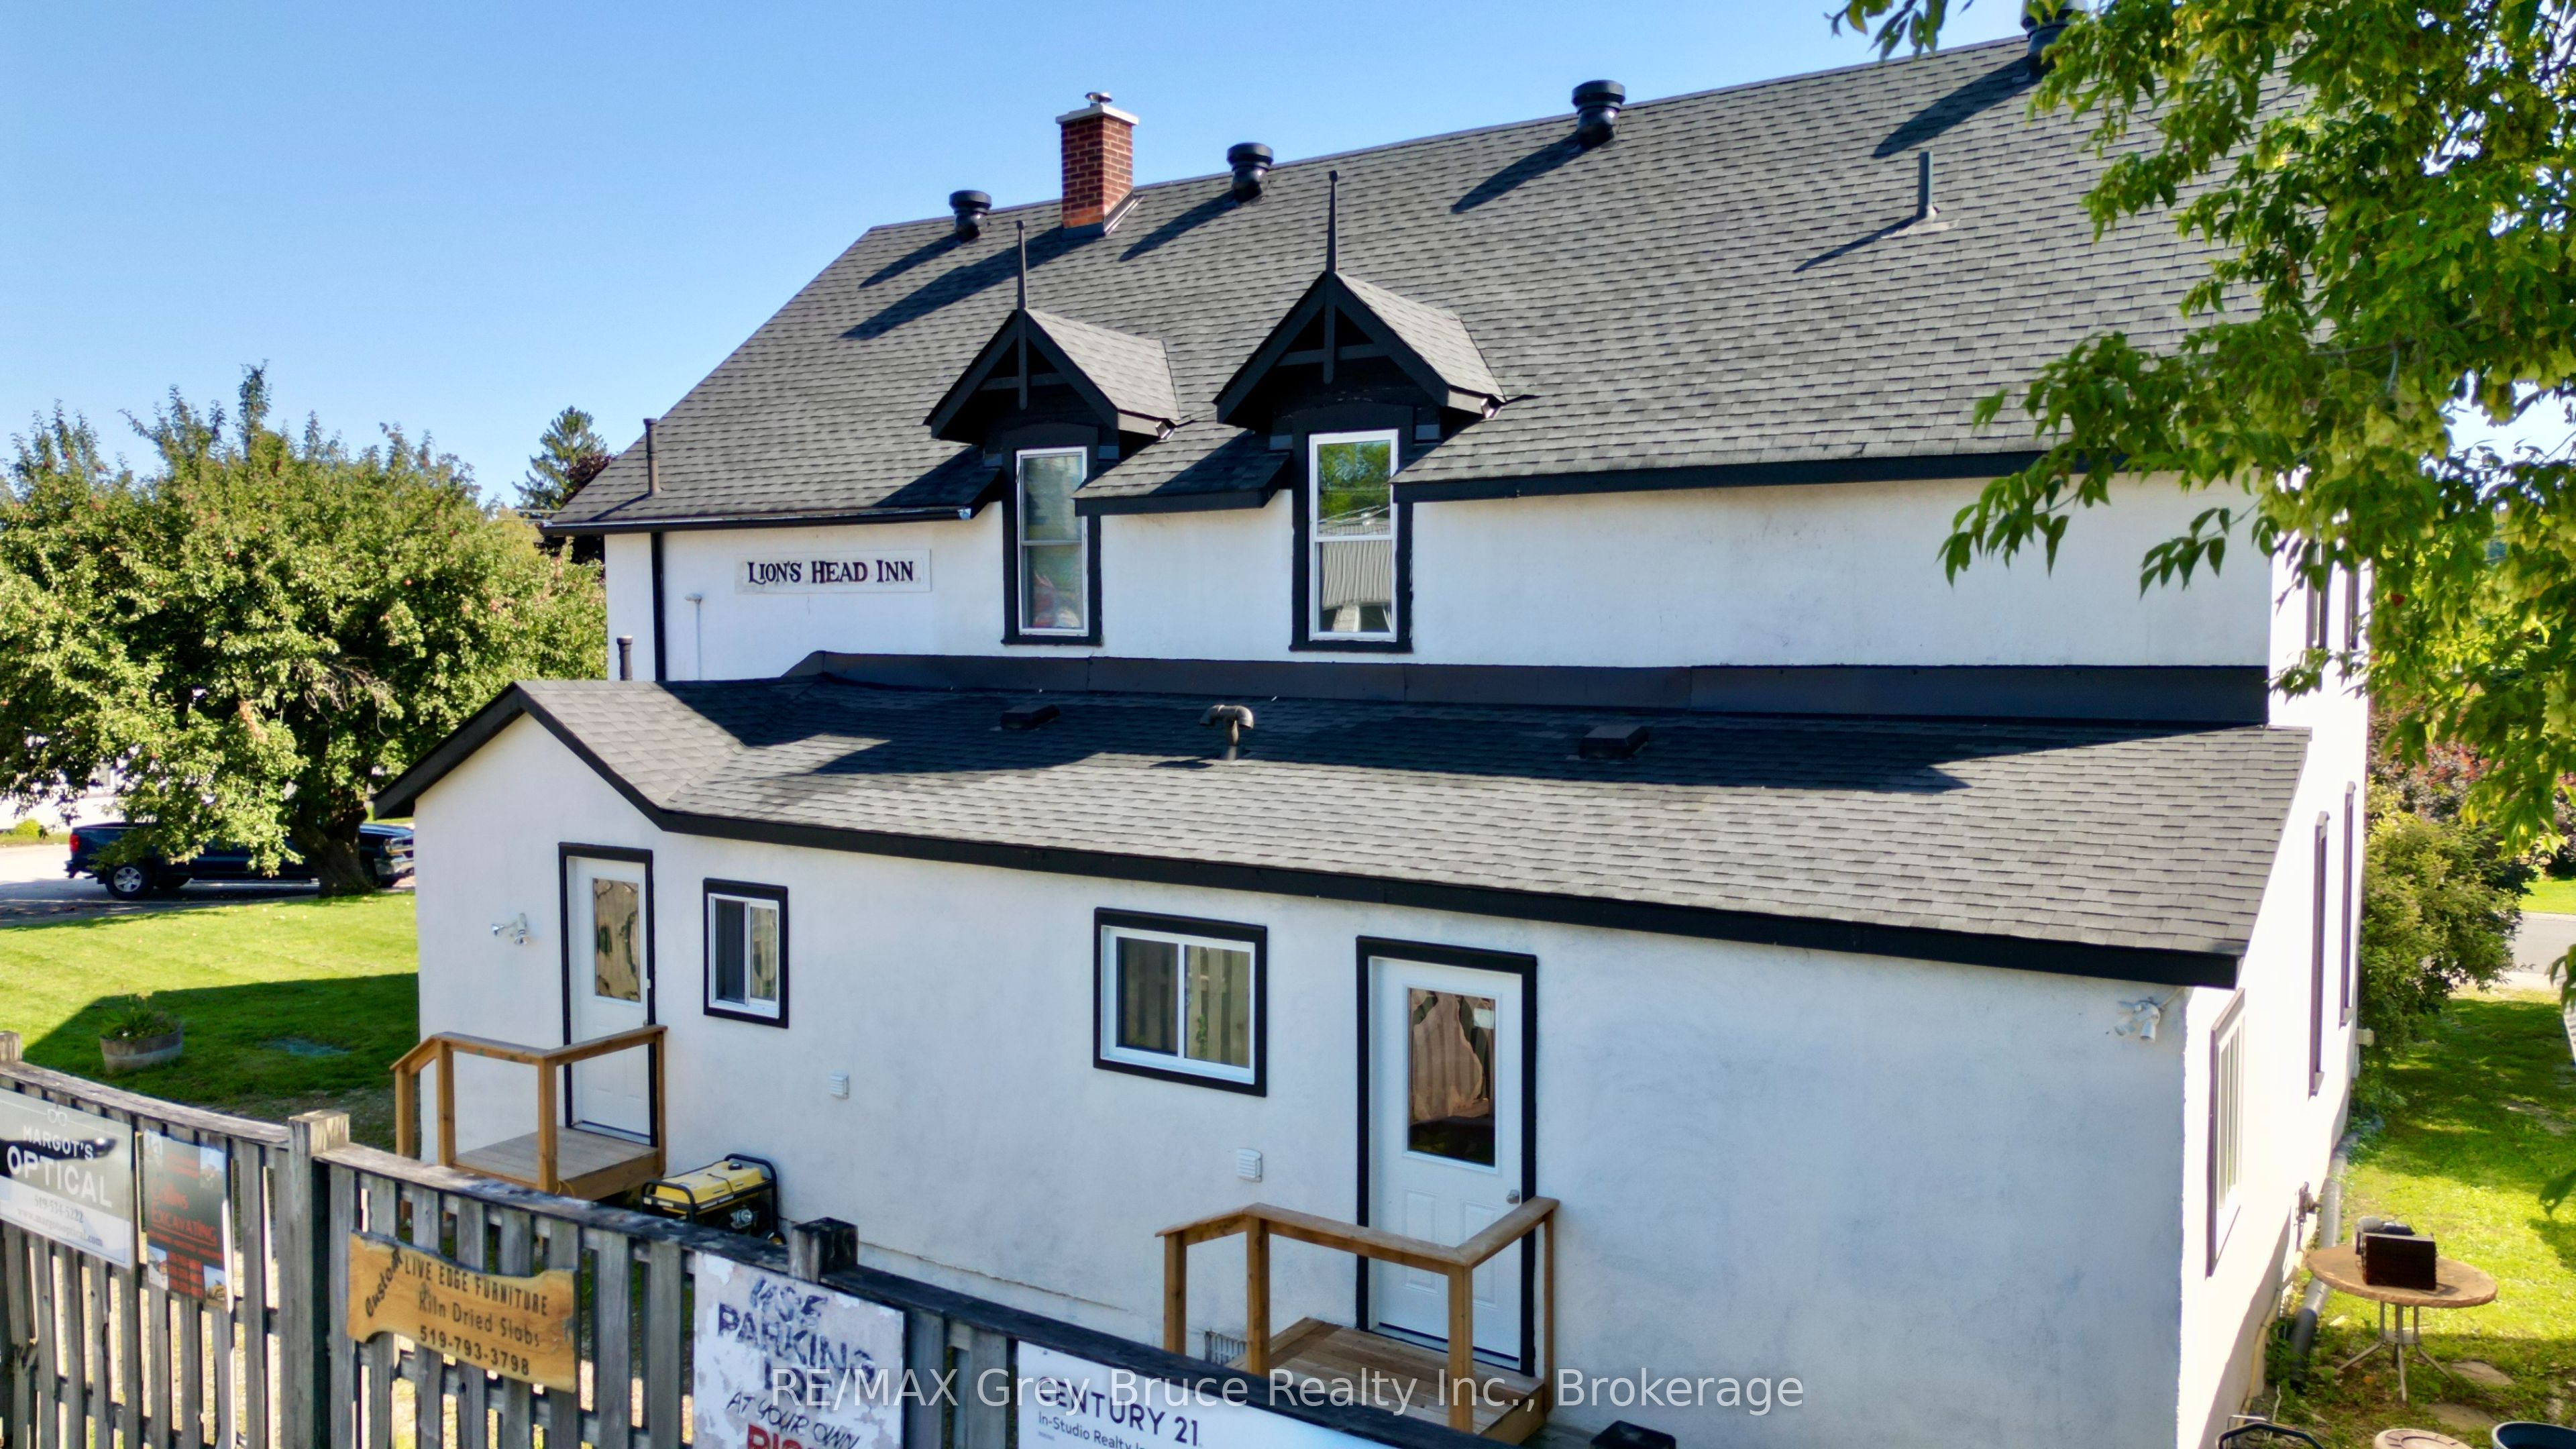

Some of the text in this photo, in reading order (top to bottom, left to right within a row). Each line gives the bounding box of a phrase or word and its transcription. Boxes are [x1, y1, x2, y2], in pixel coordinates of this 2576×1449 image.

[810, 560, 868, 584] HEAD
[876, 559, 914, 583] INN
[23, 1125, 94, 1161] MARGOT'S
[7, 1145, 113, 1208] OPTICAL
[405, 1254, 549, 1317] LIVE EDGE FURNITURE
[452, 1302, 493, 1333] Dried
[499, 1318, 541, 1348] Slabs
[420, 1326, 530, 1377] 519-793-3798
[727, 1390, 756, 1413] AT
[758, 1398, 810, 1434] YOUR
[813, 1422, 861, 1449] OWN
[1038, 1377, 1199, 1447] CENTURY 21
[1038, 1410, 1091, 1441] In-Studio
[1093, 1430, 1132, 1449] Realty
